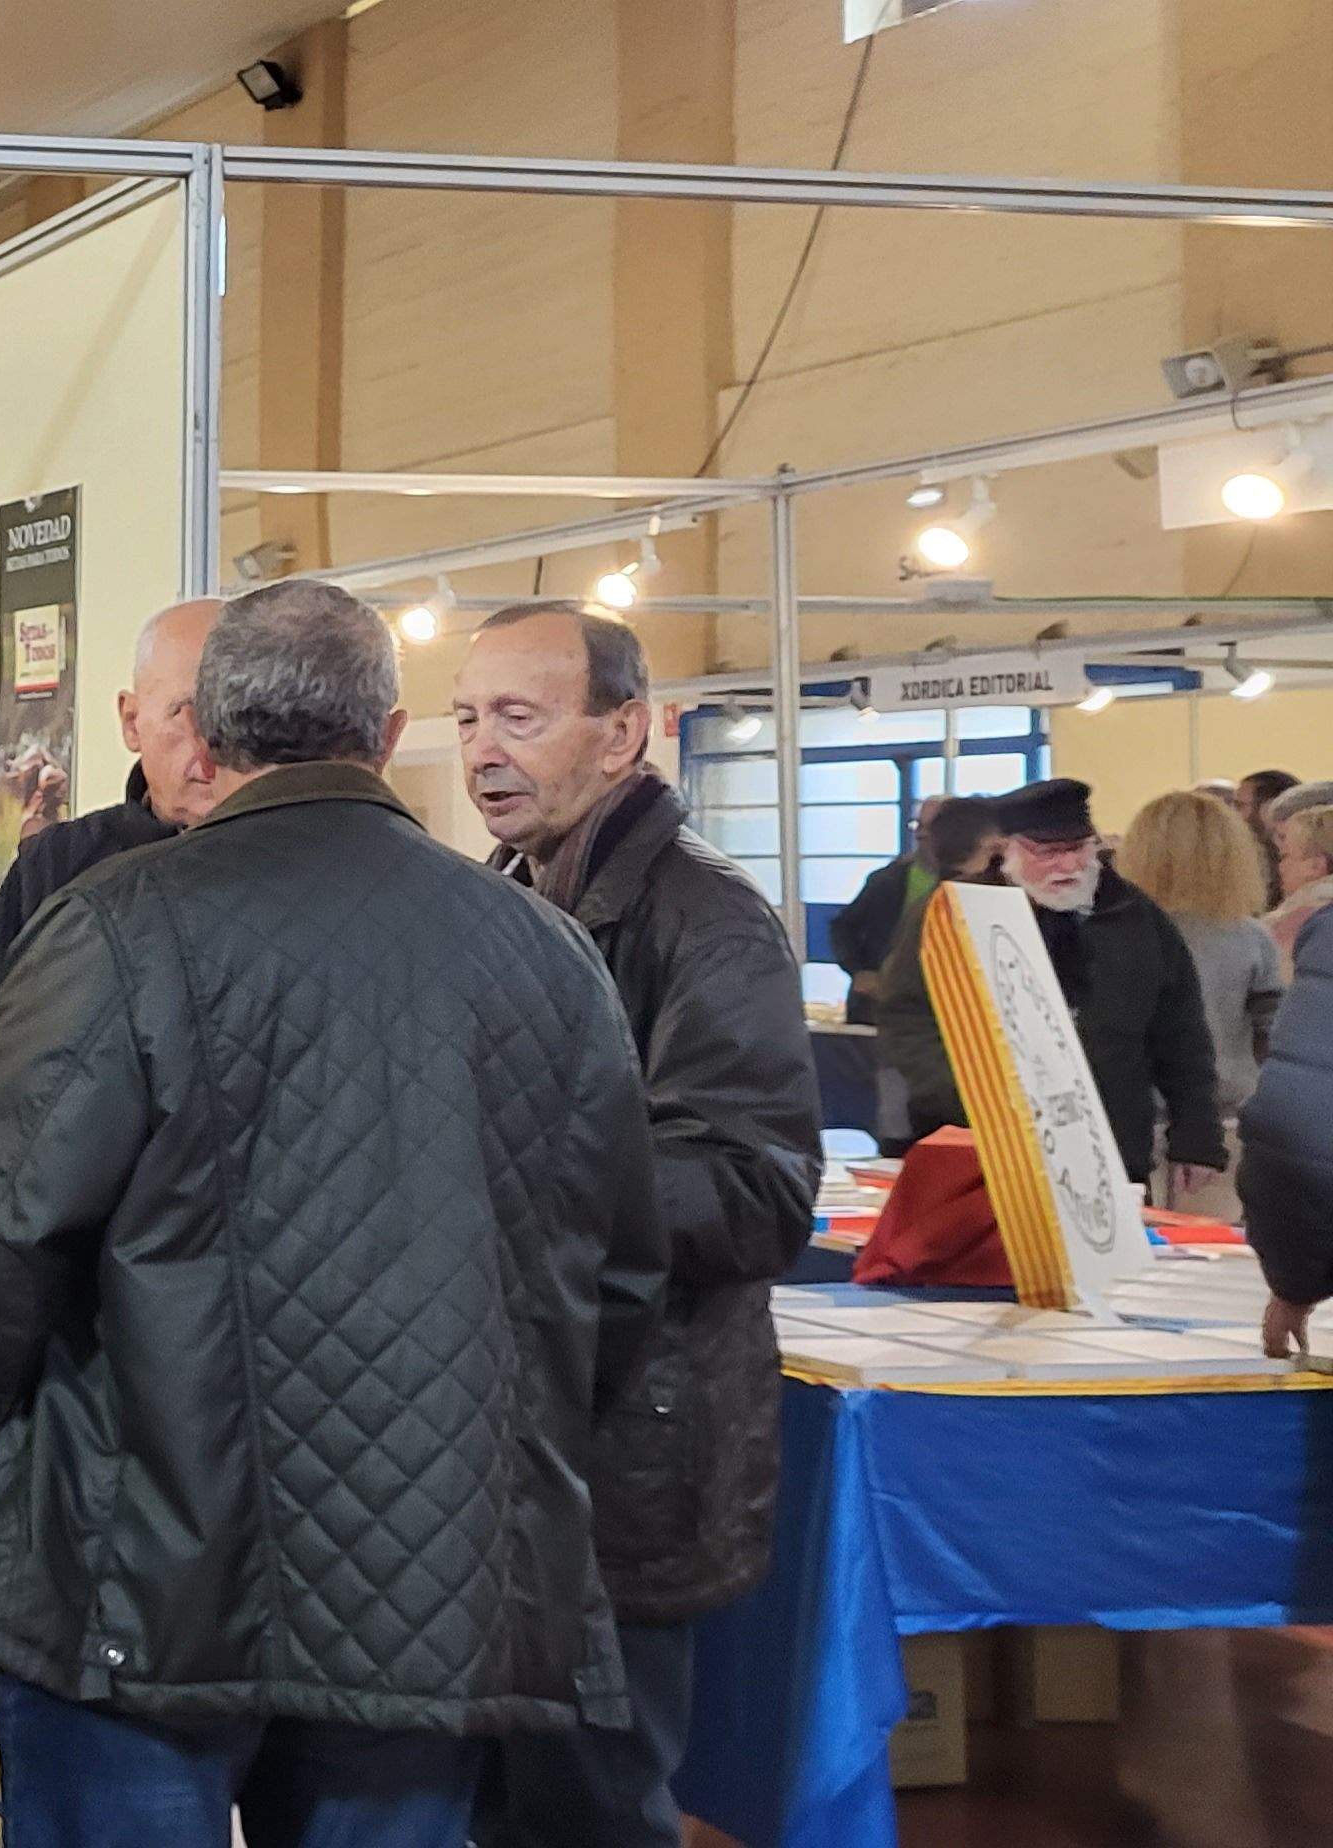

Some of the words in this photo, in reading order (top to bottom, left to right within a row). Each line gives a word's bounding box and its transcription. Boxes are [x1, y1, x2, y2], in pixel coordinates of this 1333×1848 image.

[7, 515, 72, 551] NOVEDAD
[901, 678, 964, 701] XORDICA
[970, 670, 1054, 697] EDITORIAL
